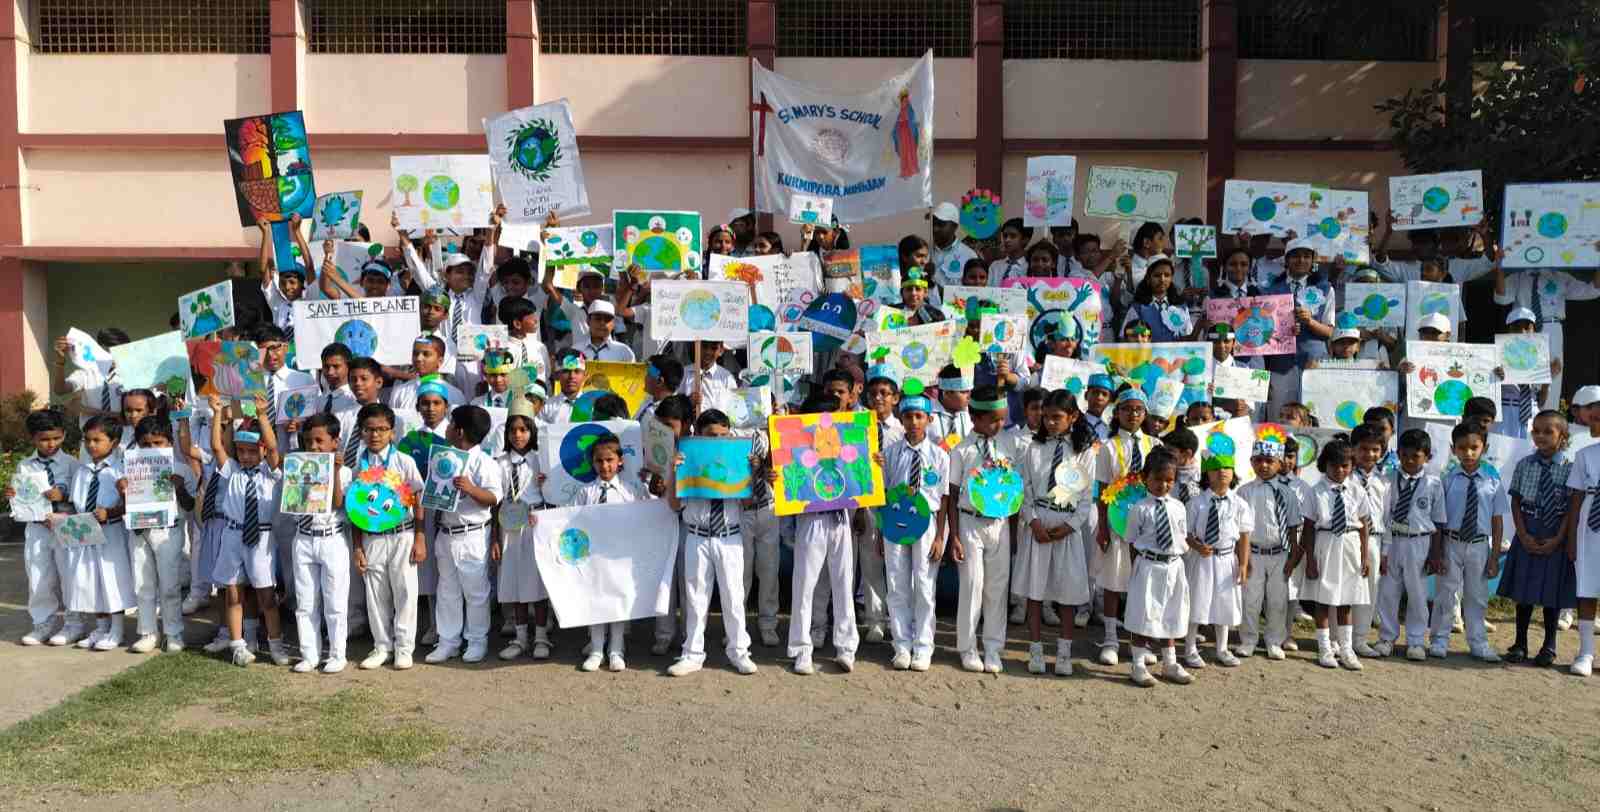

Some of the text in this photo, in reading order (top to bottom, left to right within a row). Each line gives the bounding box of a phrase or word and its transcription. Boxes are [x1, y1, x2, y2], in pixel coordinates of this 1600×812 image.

[308, 298, 416, 315] SAVE THE PLANET
